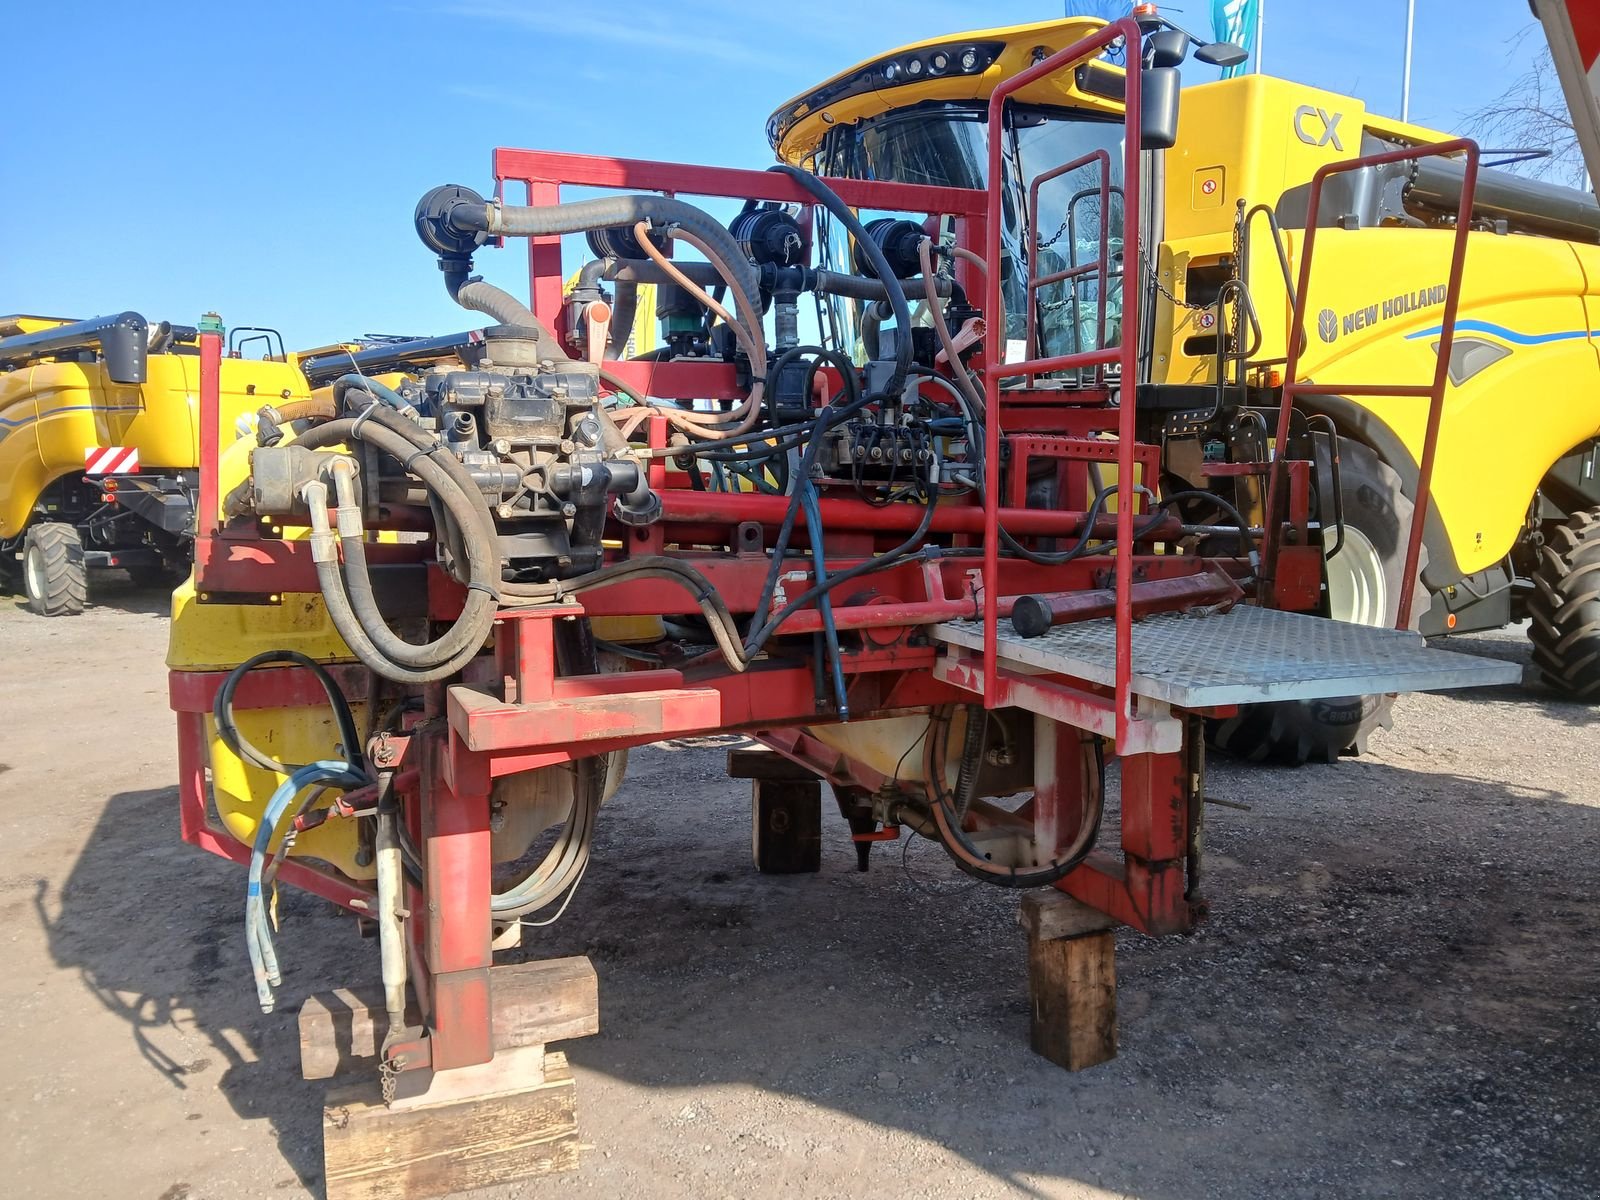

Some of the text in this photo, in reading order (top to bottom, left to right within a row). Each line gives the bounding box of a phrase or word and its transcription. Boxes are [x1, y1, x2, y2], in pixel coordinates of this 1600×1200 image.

[1294, 105, 1344, 152] CX
[1343, 284, 1447, 336] NEW HOLLAND
